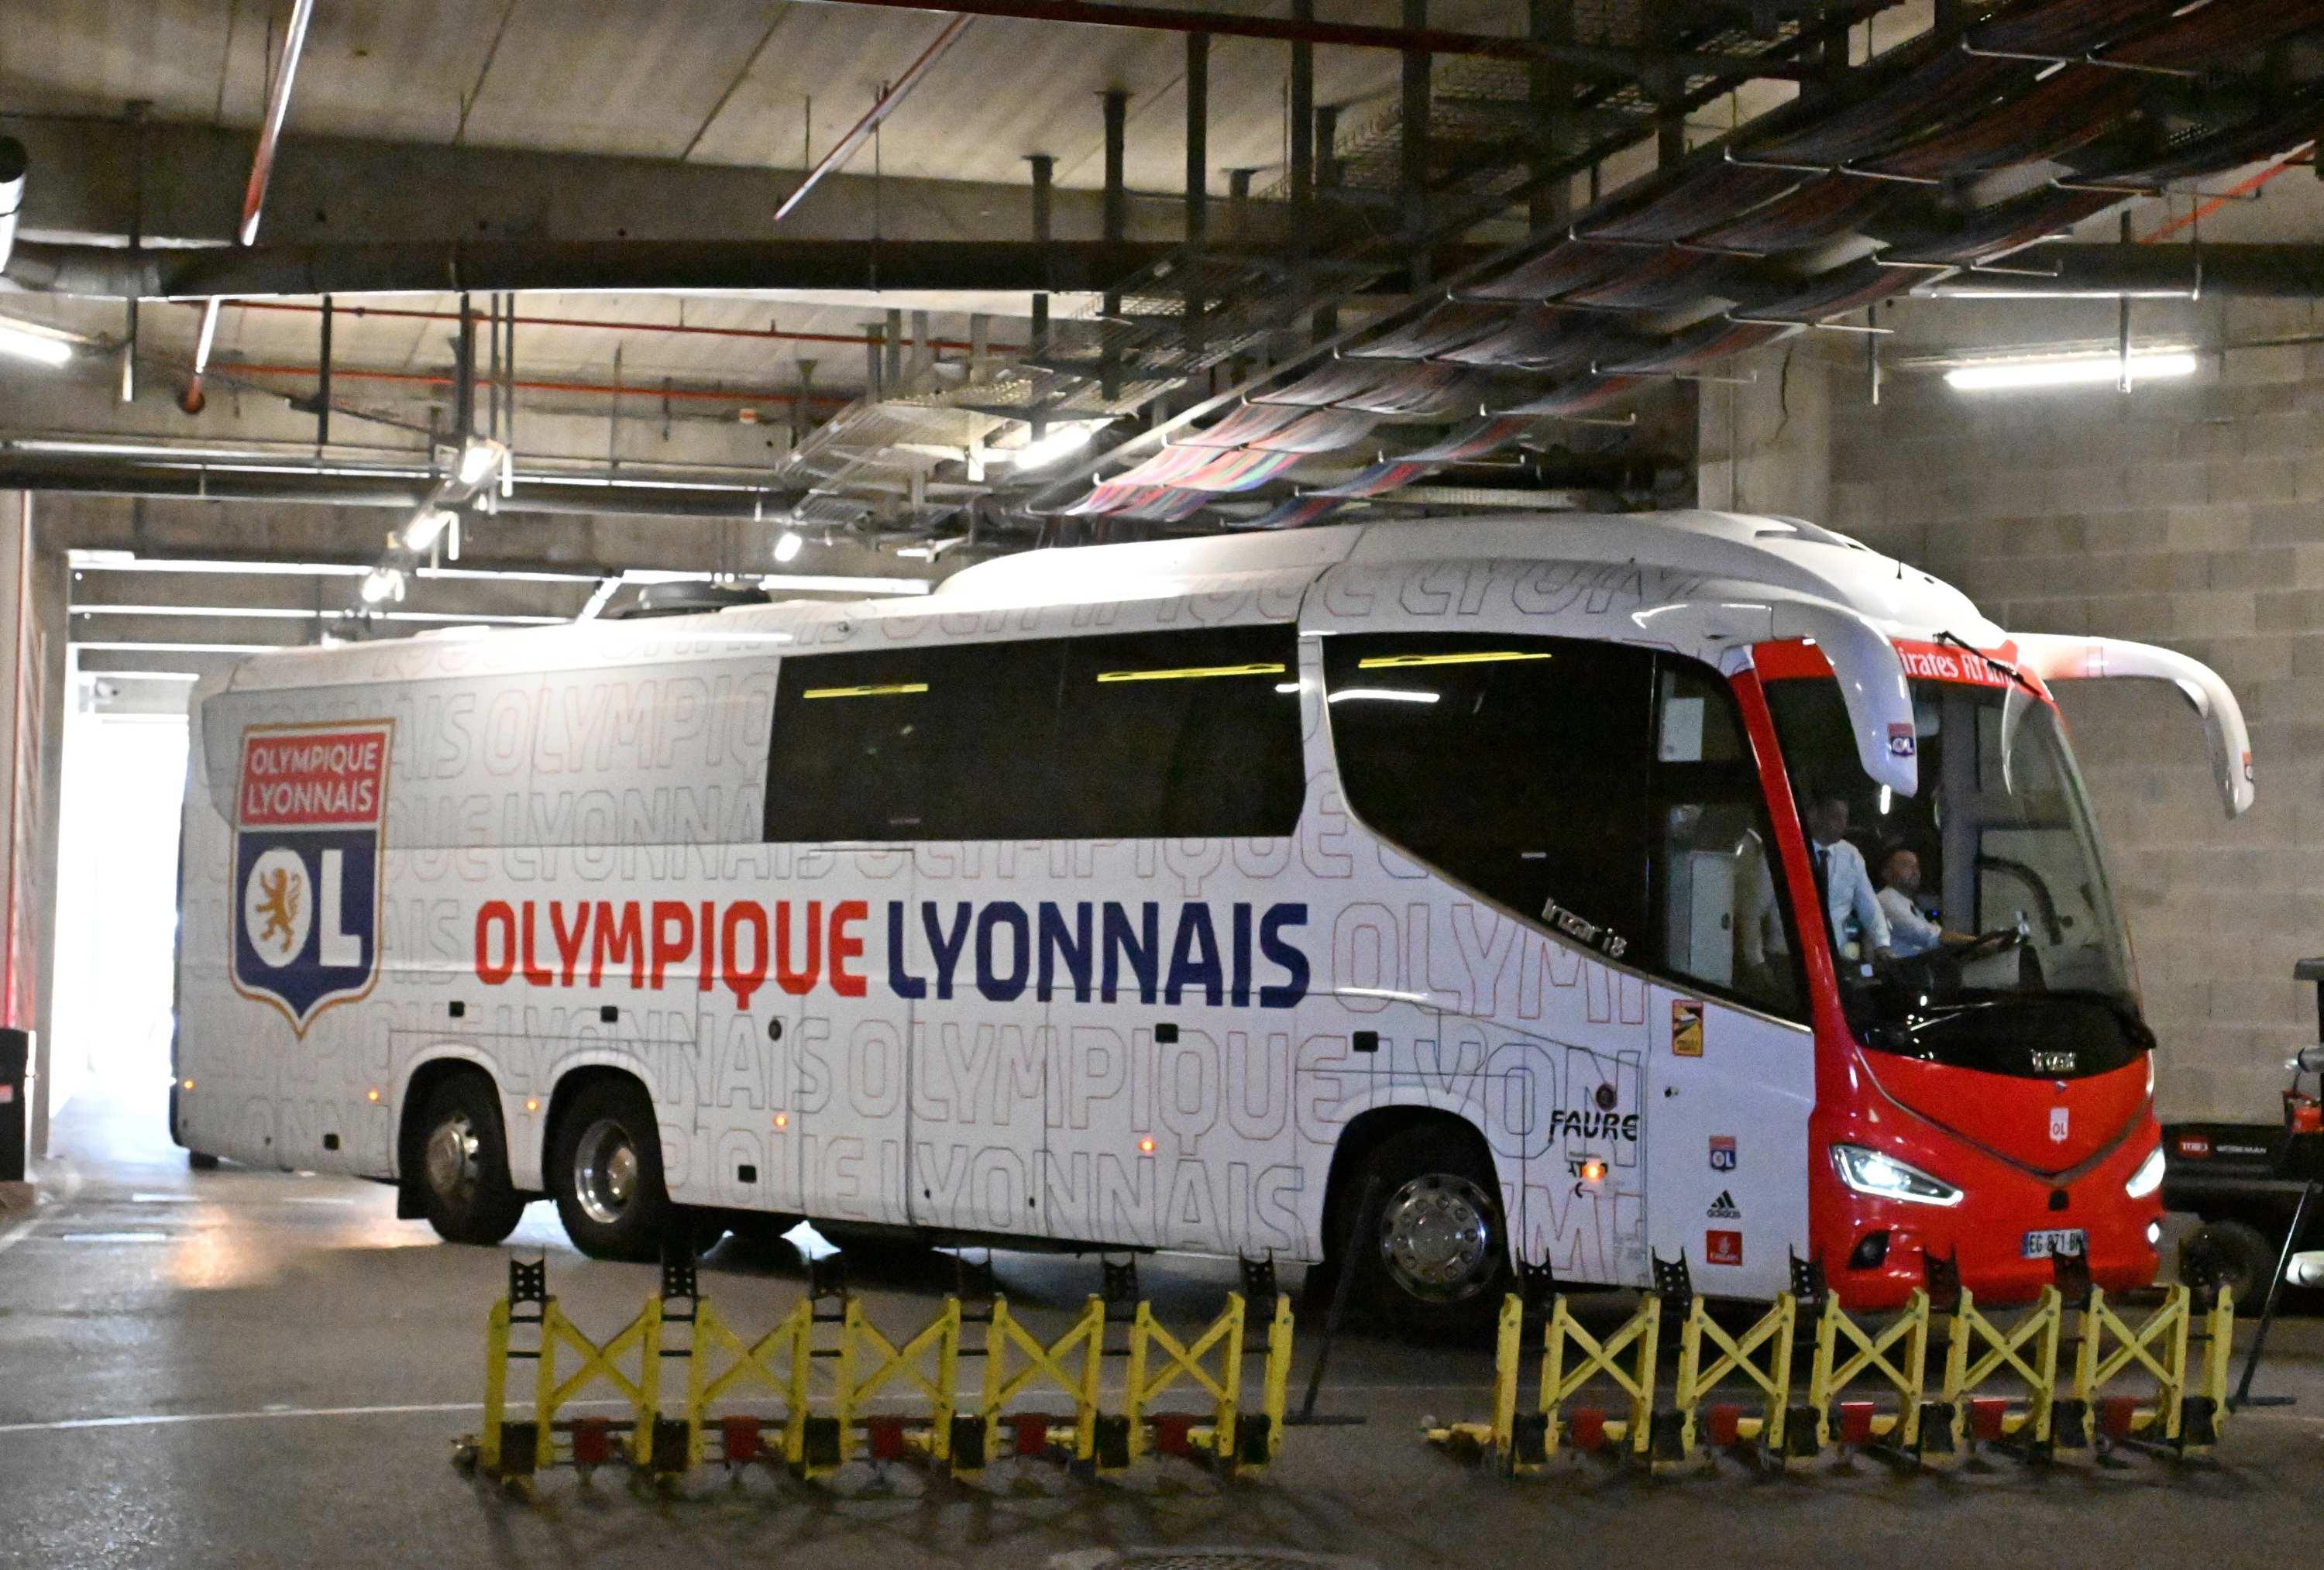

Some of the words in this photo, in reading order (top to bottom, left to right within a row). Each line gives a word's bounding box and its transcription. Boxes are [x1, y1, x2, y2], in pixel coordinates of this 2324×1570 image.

[250, 742, 378, 775] OLYMPIQUE
[247, 779, 373, 814] LYONNAIS
[245, 849, 362, 967] OL
[475, 900, 868, 1010] OLYMPIQUE
[888, 901, 1311, 1008] LYONNAIS
[1549, 1109, 1639, 1142] FAURE
[1712, 1150, 1734, 1168] OL
